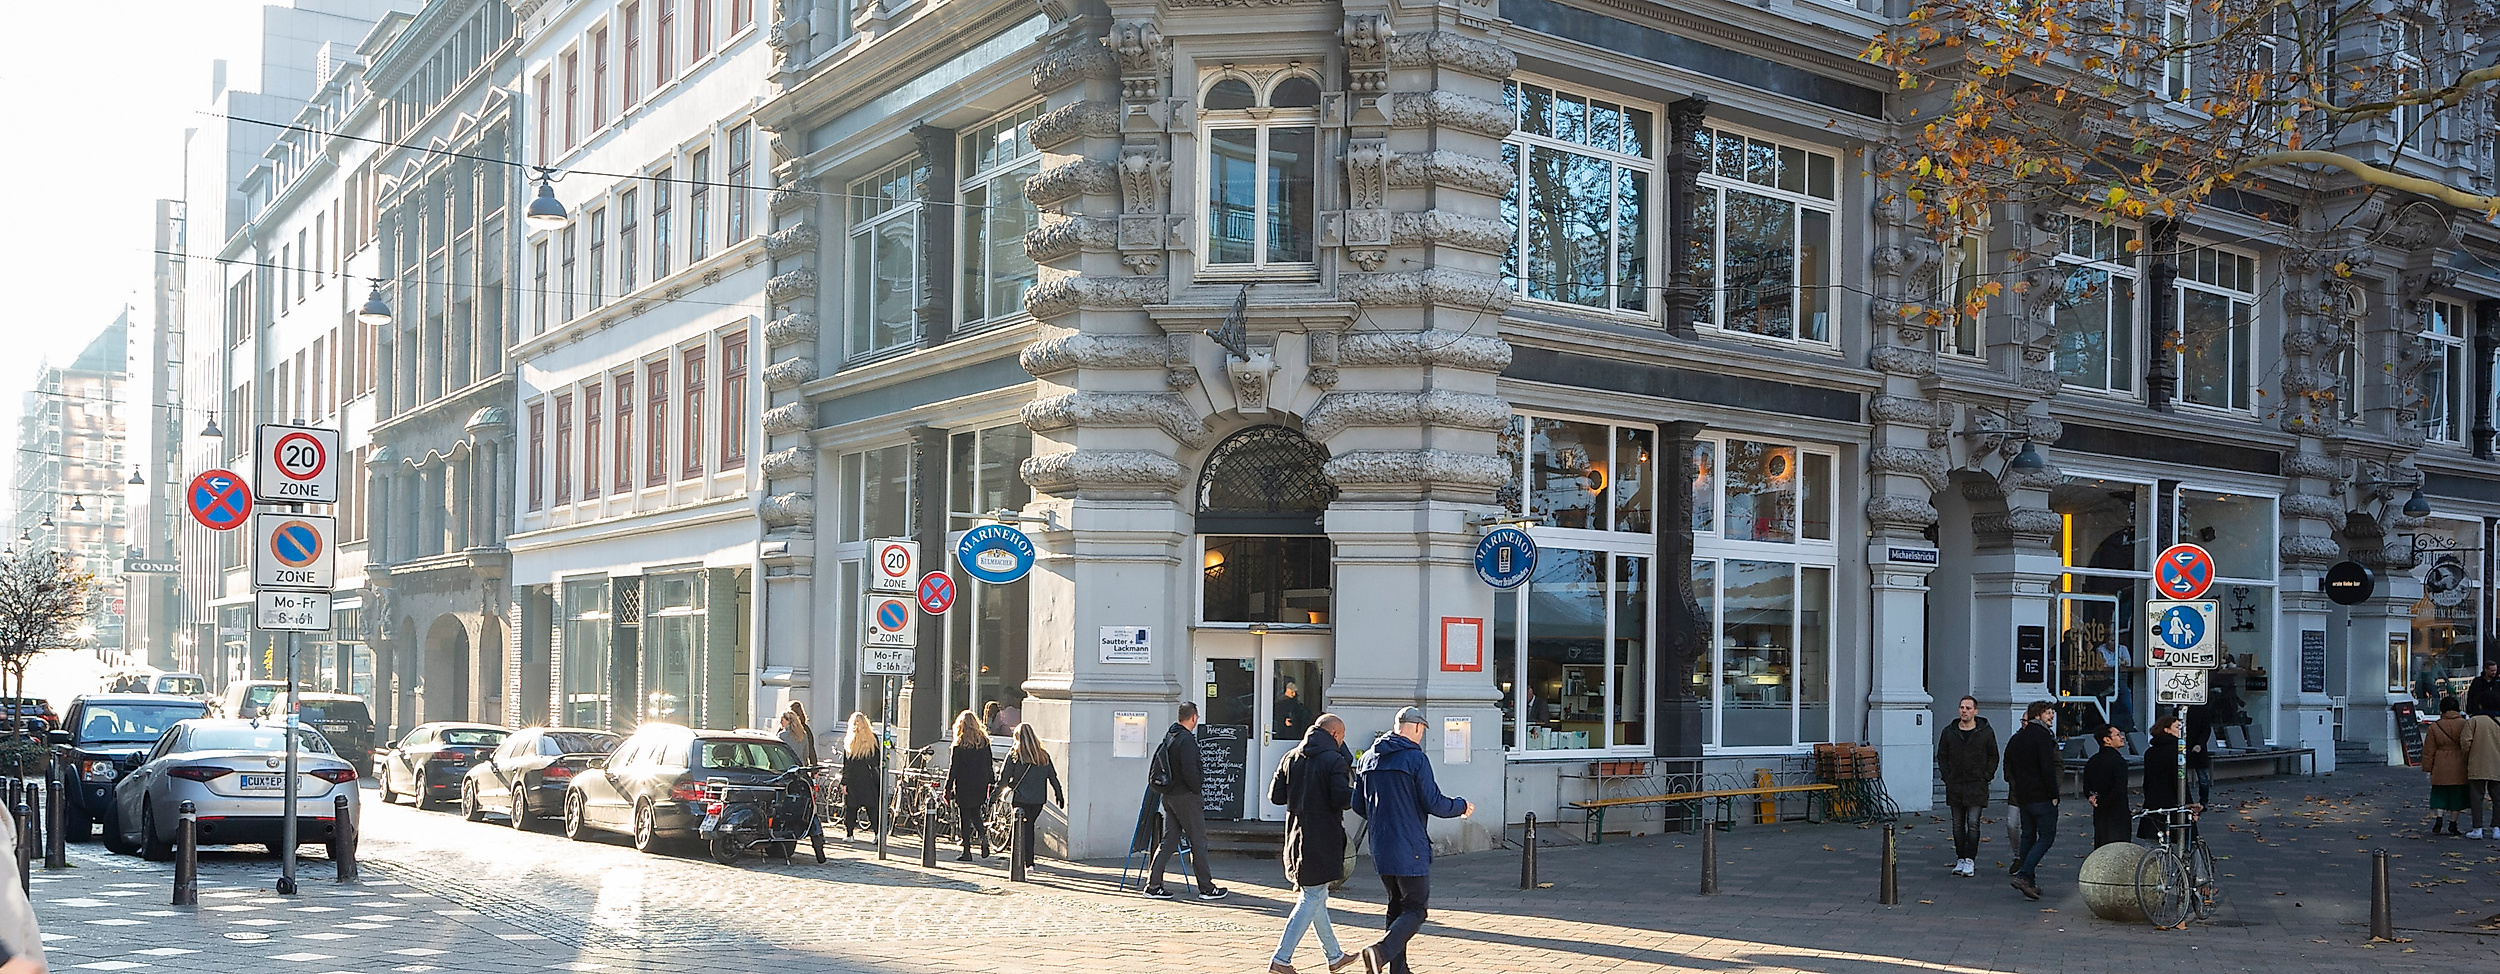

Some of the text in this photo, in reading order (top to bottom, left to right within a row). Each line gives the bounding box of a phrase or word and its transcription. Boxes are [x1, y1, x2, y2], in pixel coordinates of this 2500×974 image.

[286, 445, 315, 468] 20
[279, 482, 319, 497] ZONE
[961, 528, 1033, 557] MARINEHOF
[1476, 531, 1533, 563] MARINEHOF
[887, 553, 905, 568] 20
[1891, 549, 1935, 561] Michaelisbrücke
[276, 570, 315, 584] ZONE
[883, 579, 907, 588] ZONE
[274, 596, 316, 609] Mo-Fr
[880, 633, 904, 643] ZONE
[1101, 637, 1128, 645] Sautter
[874, 651, 902, 660] Mo-Fr
[2164, 652, 2199, 664] ZONE
[2174, 690, 2189, 699] frei
[248, 776, 266, 786] CUX
[271, 776, 282, 786] EP
